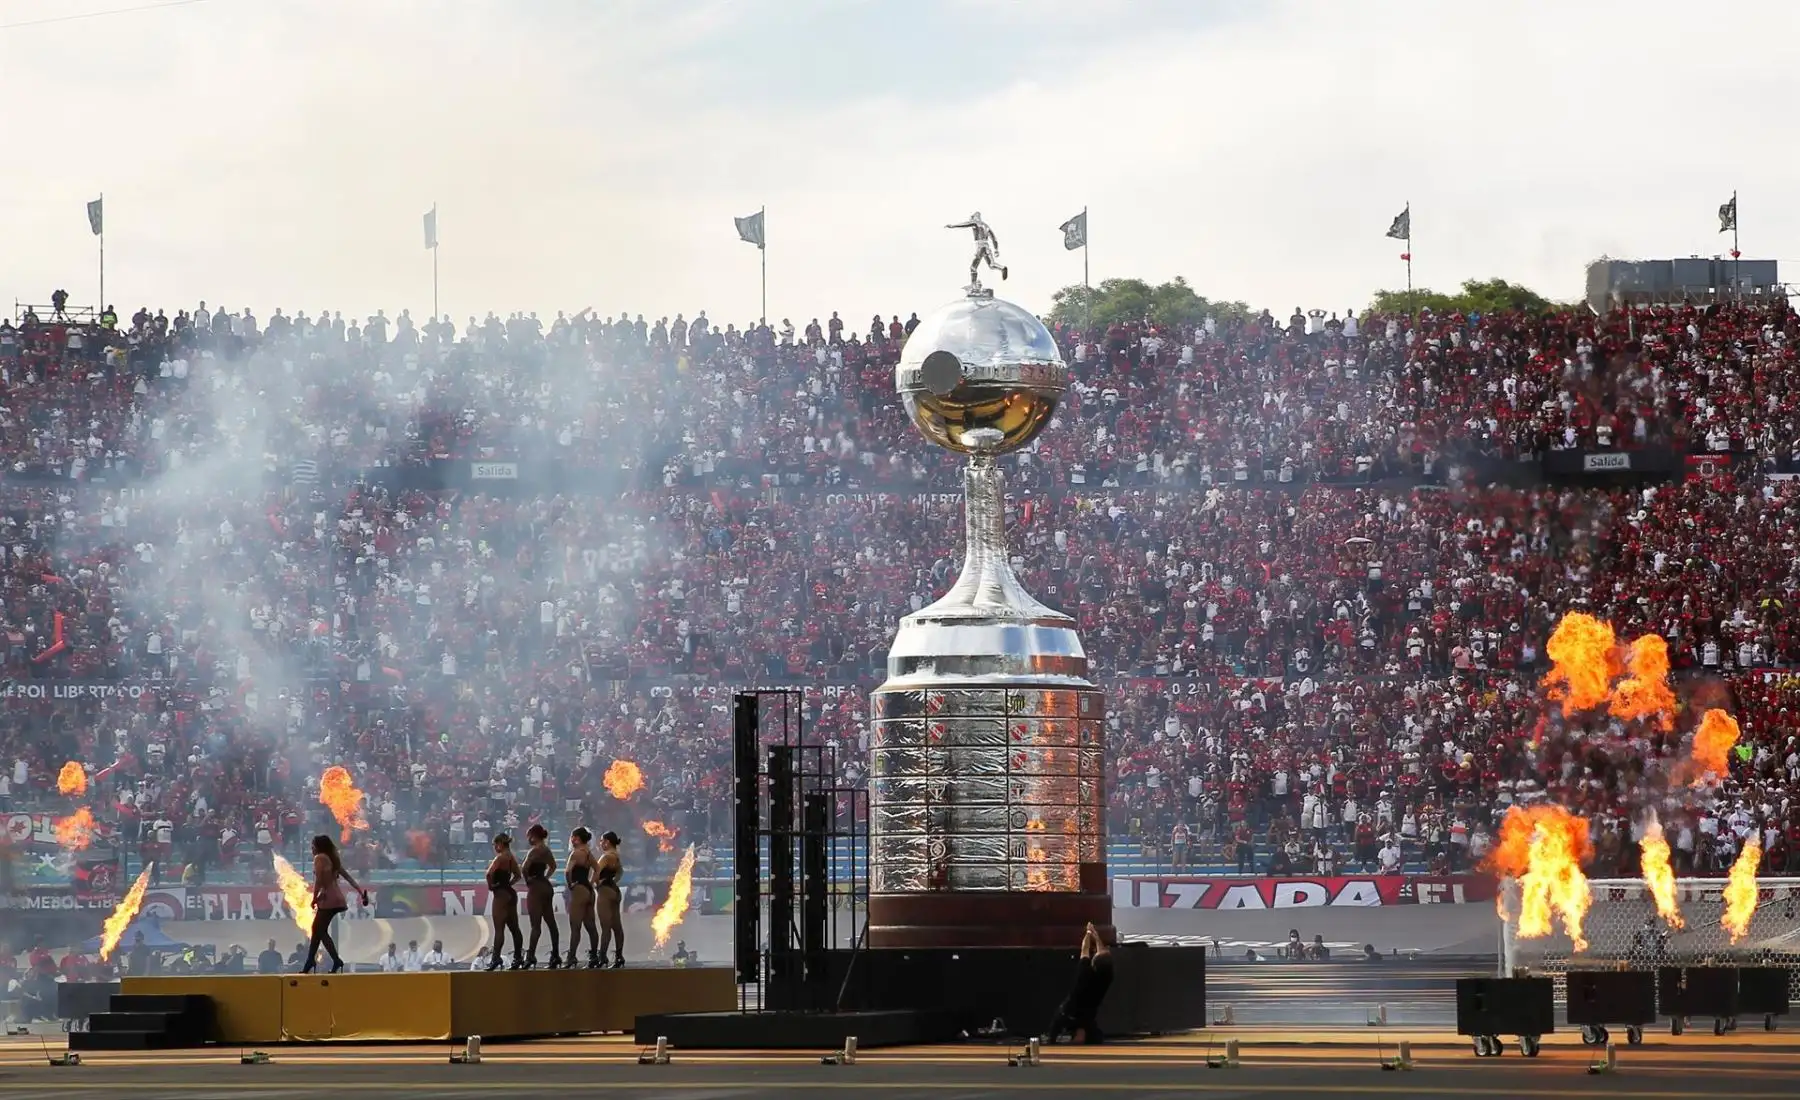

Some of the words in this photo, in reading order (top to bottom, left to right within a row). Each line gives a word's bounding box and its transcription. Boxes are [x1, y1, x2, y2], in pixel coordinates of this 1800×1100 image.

[1590, 455, 1625, 468] Salida
[478, 465, 513, 477] Salida
[1047, 585, 1057, 595] 10
[1171, 682, 1211, 695] 021
[201, 893, 257, 921] FLA
